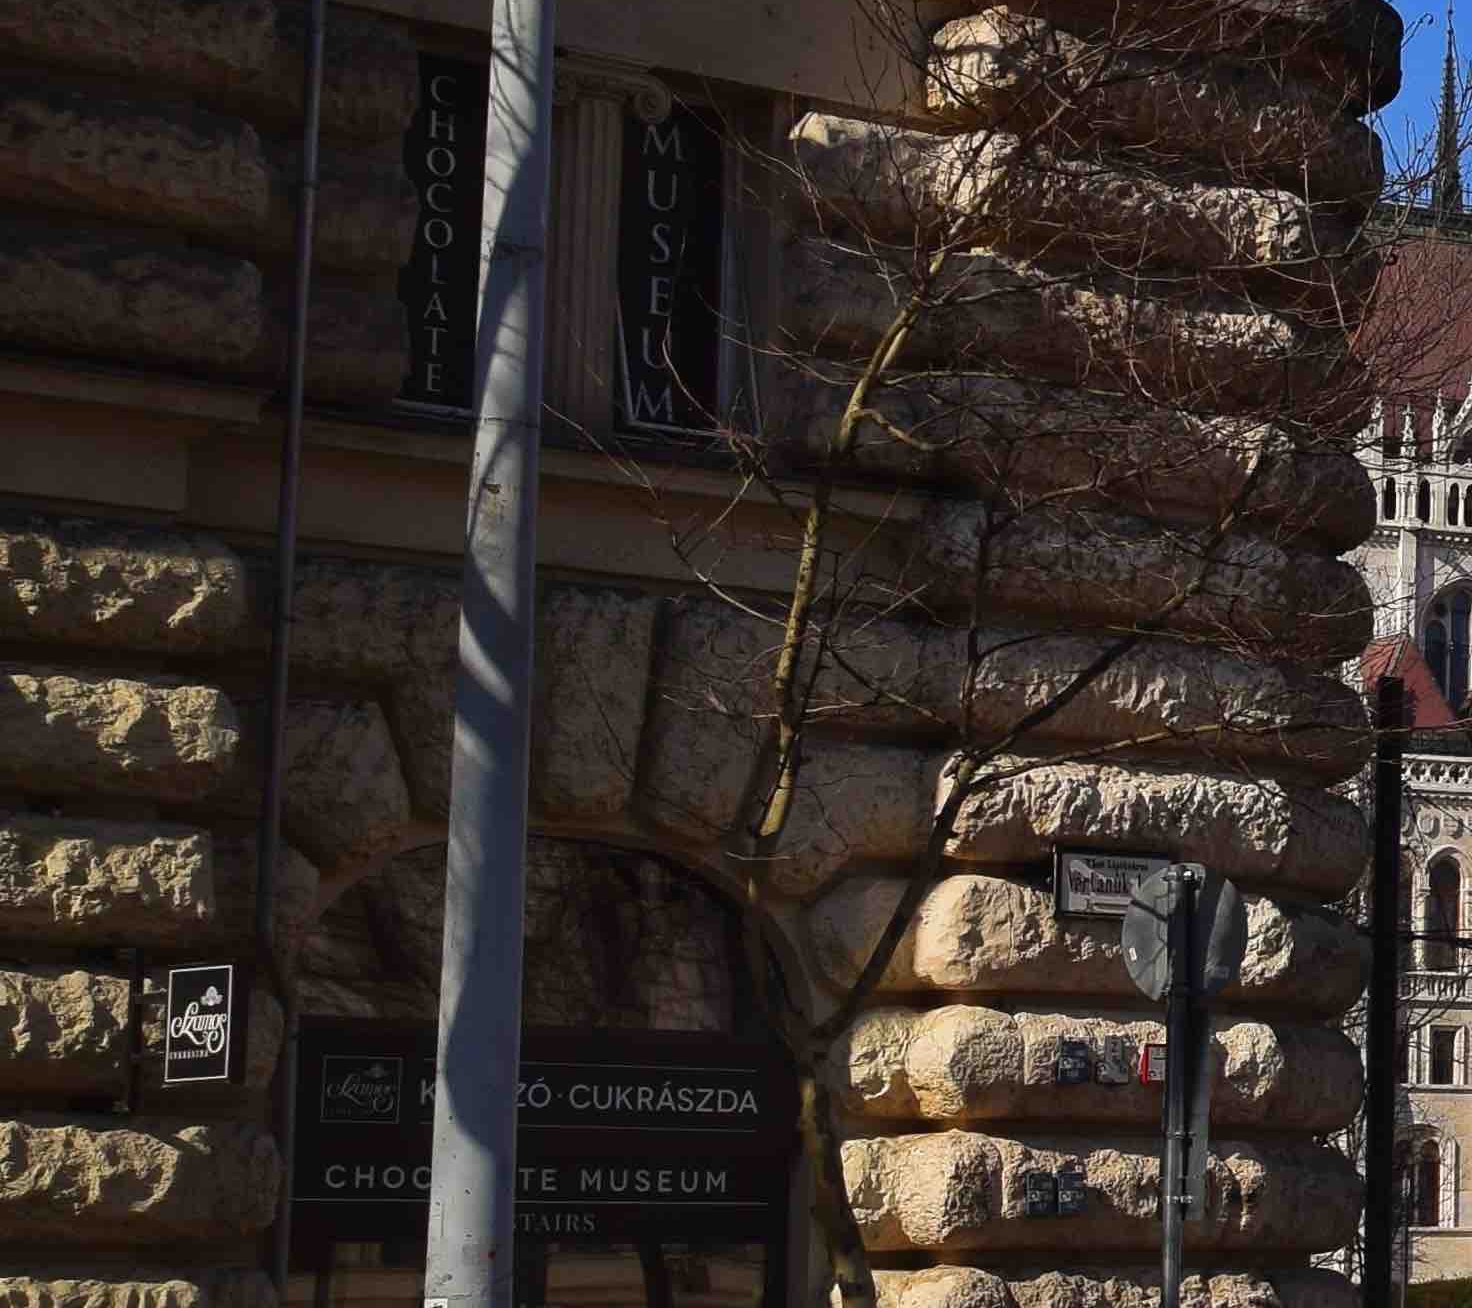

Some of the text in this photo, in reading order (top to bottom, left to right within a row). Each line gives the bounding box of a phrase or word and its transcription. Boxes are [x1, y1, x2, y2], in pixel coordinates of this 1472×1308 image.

[423, 75, 458, 393] CHOCOLATE
[632, 123, 685, 423] MUSEUM
[324, 1165, 728, 1194] CHOCTE MUSEUM
[419, 1076, 759, 1115] KZÓ CUKRÁSZDA
